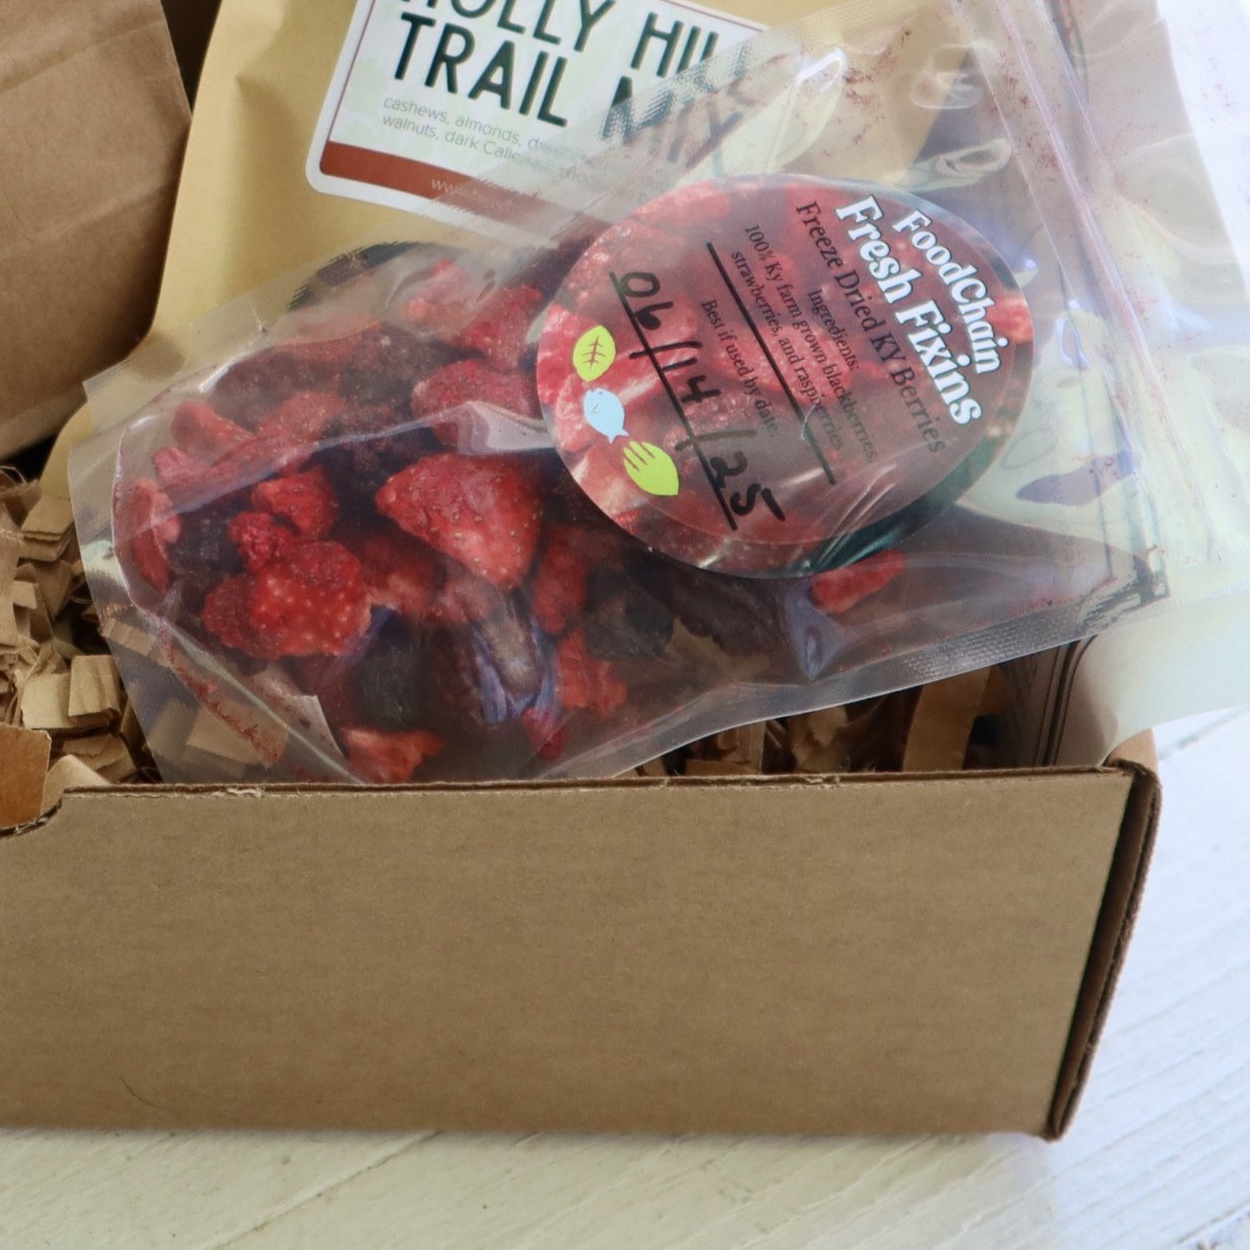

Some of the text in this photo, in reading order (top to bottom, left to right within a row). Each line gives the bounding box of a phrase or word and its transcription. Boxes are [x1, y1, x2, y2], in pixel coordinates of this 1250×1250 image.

[394, 11, 568, 128] TRAIL
[383, 96, 450, 124] cashews,
[455, 114, 522, 148] almonds,
[383, 113, 439, 141] walnuts,
[444, 130, 478, 150] dark
[701, 300, 726, 332] Best
[744, 224, 776, 263] 100%
[764, 260, 784, 283] Ky
[777, 283, 803, 319] farm
[791, 318, 828, 364] grown
[797, 200, 946, 454] Freeze Dried KY Berries
[807, 289, 860, 372] Ingredients:
[835, 193, 982, 425] Fresh Fixins
[891, 209, 1009, 375] FoodChain
[718, 327, 738, 343] if
[725, 340, 752, 376] used
[731, 252, 846, 451] strawberries, and raspberries
[743, 370, 761, 400] by
